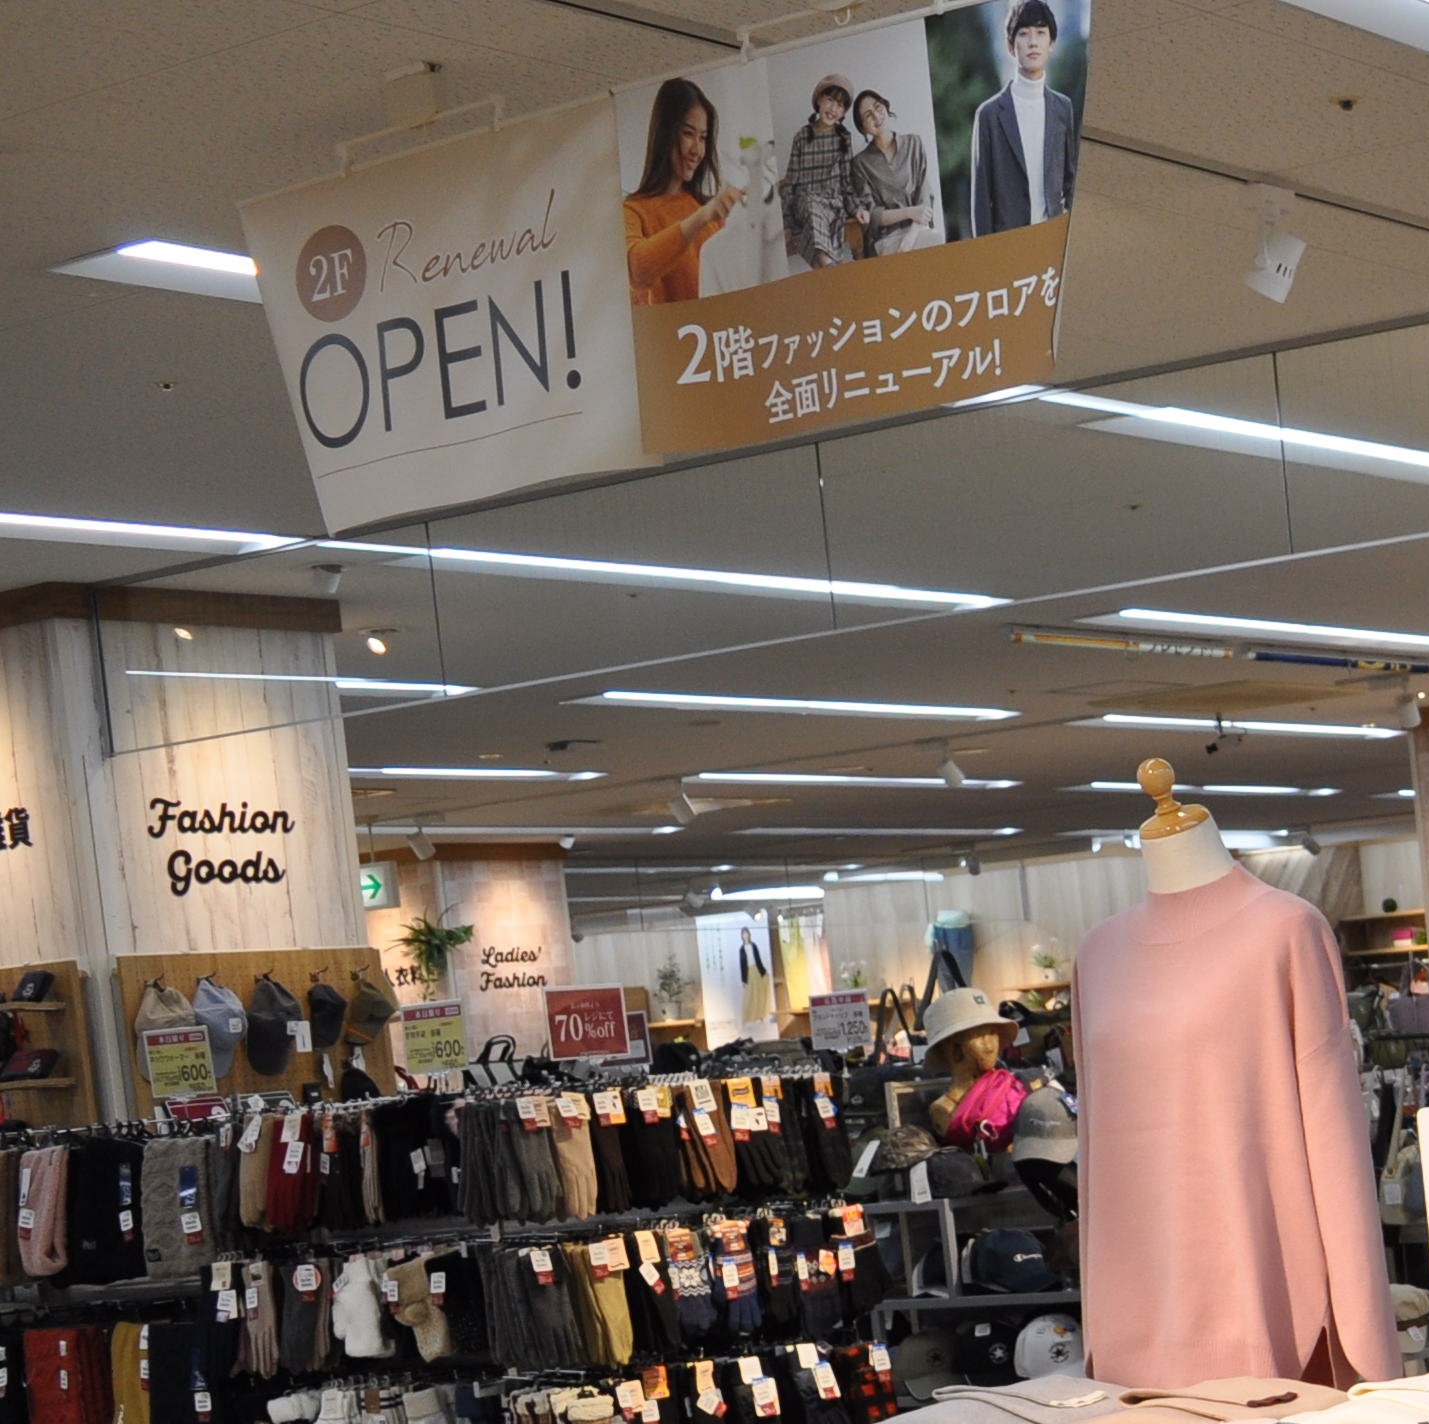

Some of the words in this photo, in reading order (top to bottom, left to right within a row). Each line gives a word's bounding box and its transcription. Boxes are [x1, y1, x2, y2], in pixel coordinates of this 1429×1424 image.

[307, 248, 355, 304] 2F
[378, 188, 558, 293] Renewal
[676, 267, 1061, 387] 2階ファッションのフロアを
[299, 270, 583, 450] OPEN!
[765, 351, 1003, 426] 全面リニューアル!
[147, 797, 295, 838] Fashion
[168, 850, 285, 896] Goods
[481, 947, 542, 968] Ladies'
[480, 971, 548, 992] Fashion
[435, 1040, 460, 1058] 600
[181, 1064, 207, 1081] 600
